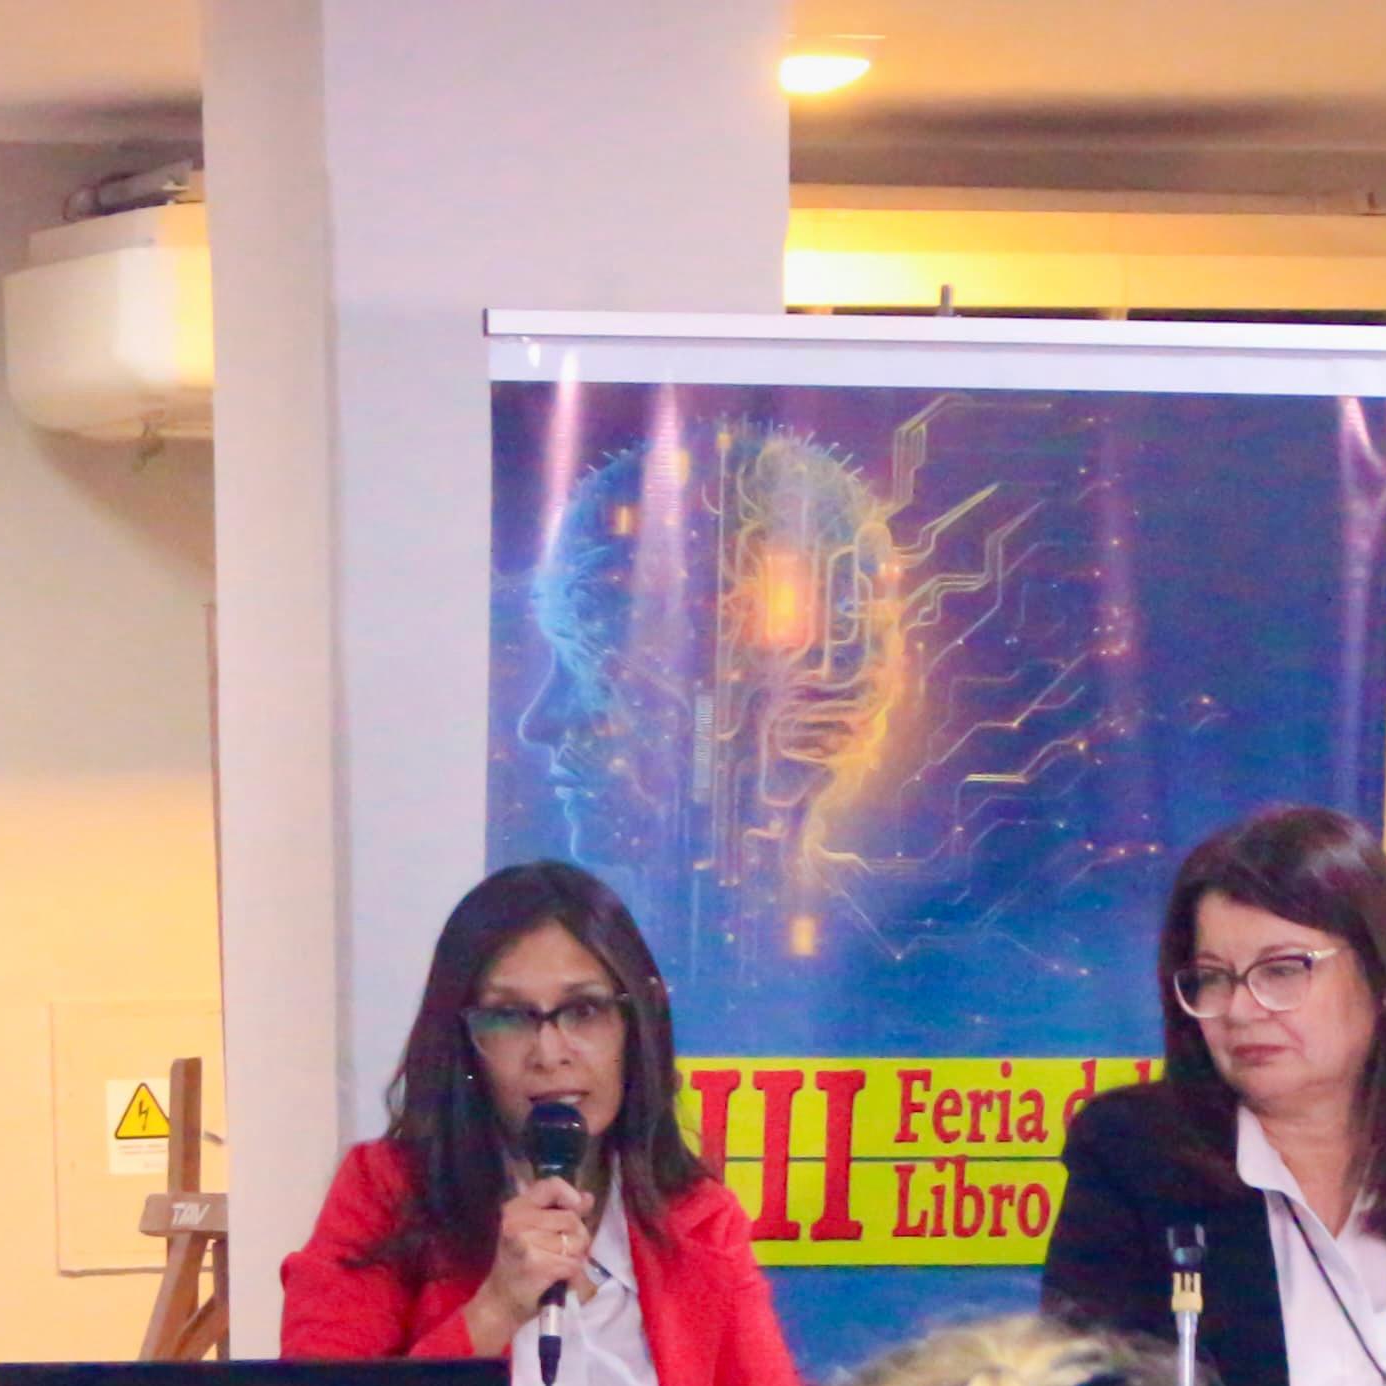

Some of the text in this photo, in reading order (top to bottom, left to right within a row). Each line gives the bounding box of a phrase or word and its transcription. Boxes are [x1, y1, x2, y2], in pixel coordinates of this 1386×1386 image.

[894, 1061, 1048, 1143] Feria
[675, 1069, 866, 1241] III
[892, 1154, 1051, 1238] Libro
